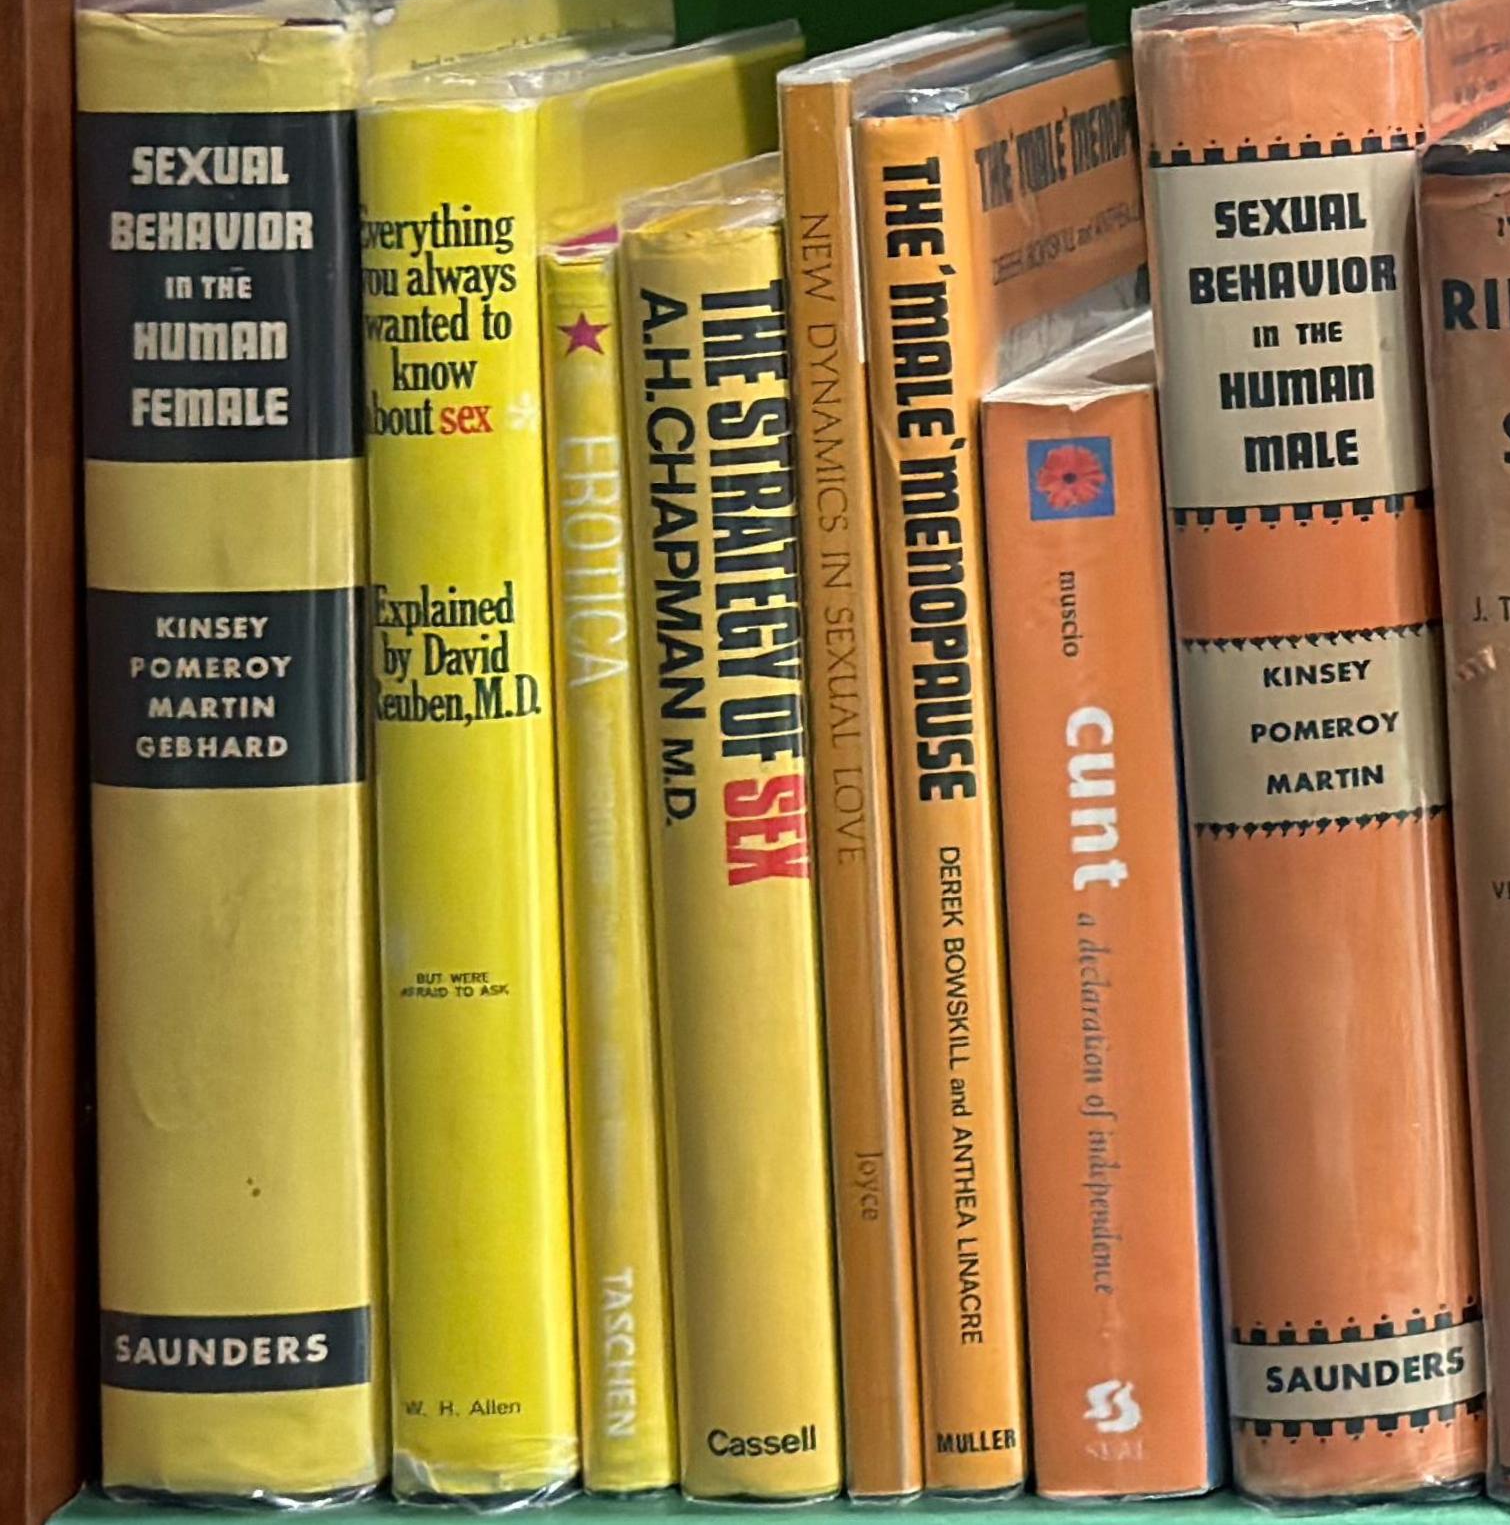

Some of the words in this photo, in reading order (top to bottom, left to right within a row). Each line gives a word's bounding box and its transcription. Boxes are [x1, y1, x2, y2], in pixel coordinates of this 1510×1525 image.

[131, 145, 289, 185] SEXUAL
[111, 210, 313, 251] BEHAVIOR
[1214, 192, 1367, 239] SEXUAL
[407, 251, 517, 301] always
[800, 213, 834, 302] NEW
[202, 275, 252, 300] THE
[1189, 254, 1397, 304] BEHAVIOR
[133, 320, 288, 361] HUMAN
[483, 303, 513, 341] to
[1295, 321, 1343, 345] THE
[392, 346, 478, 391] know
[1219, 363, 1375, 410] HUMAN
[132, 386, 289, 427] FEMALE
[440, 405, 494, 435] sex
[808, 323, 849, 532] DYNAMICS
[1244, 428, 1359, 473] MALE
[821, 552, 852, 589] IN
[156, 616, 268, 640] KINSEY
[1059, 570, 1084, 658] muscio
[130, 655, 292, 679] POMEROY
[383, 631, 412, 683] by
[424, 630, 509, 676] David
[1263, 660, 1371, 688] KINSEY
[824, 607, 862, 750] SEXUAL
[147, 694, 276, 720] MARTIN
[1251, 711, 1400, 744] POMEROY
[135, 733, 289, 760] GEBHARD
[1066, 706, 1129, 892] cunt
[1266, 765, 1384, 796] MARTIN
[831, 767, 868, 865] LOVE
[939, 846, 964, 928] DEREK
[943, 937, 971, 1070] BOWSKILL
[949, 1078, 973, 1117] and
[855, 1152, 883, 1222] Joyce
[952, 1126, 977, 1229] ANTHEA
[957, 1237, 983, 1346] LINACRE
[115, 1335, 329, 1367] SAUNDERS
[1266, 1346, 1465, 1393] SAUNDERS
[469, 1398, 521, 1415] Allen
[707, 1425, 816, 1457] Cassell
[937, 1428, 1017, 1454] MULLER
